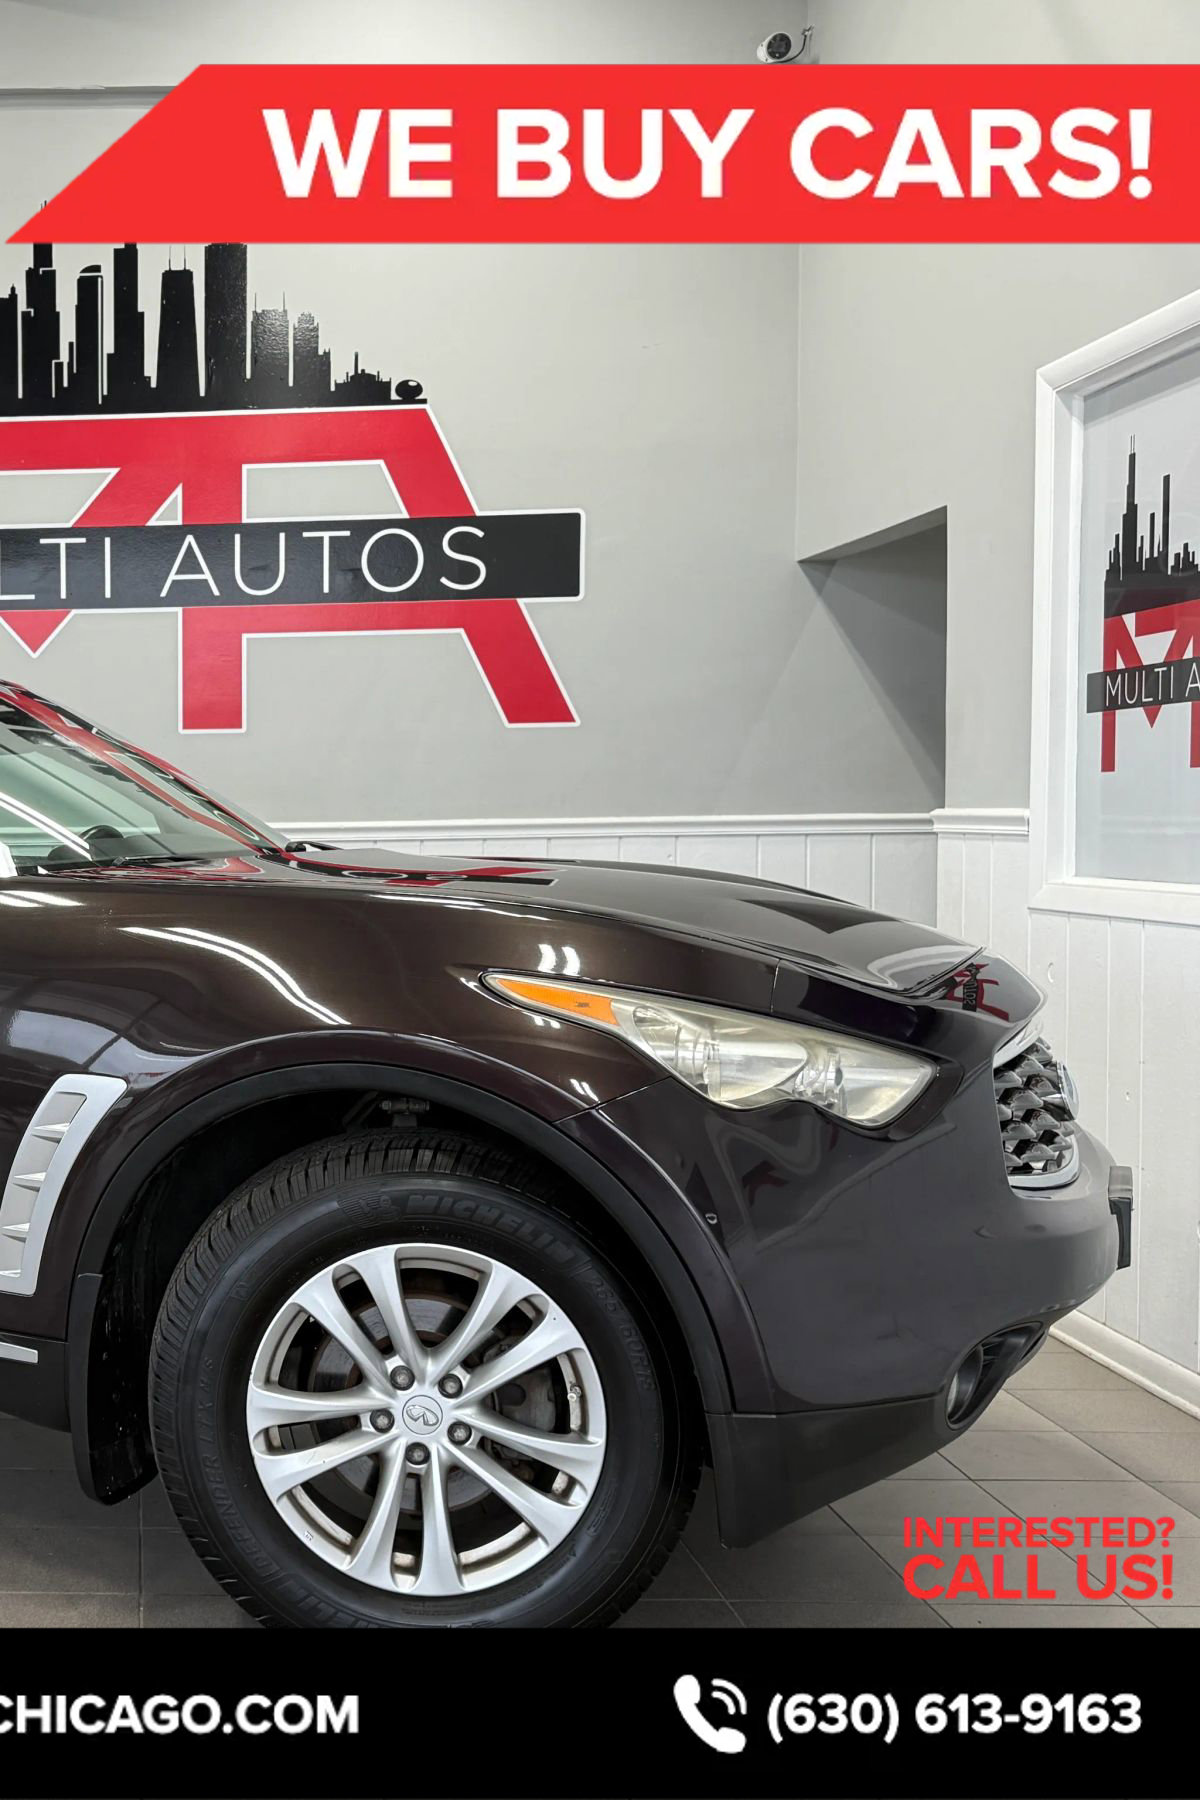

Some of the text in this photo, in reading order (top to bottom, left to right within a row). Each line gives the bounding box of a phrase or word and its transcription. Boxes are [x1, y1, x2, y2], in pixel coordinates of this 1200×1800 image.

[161, 526, 488, 600] AUTOS
[1105, 665, 1175, 708] MULTI
[404, 1193, 580, 1264] MICHELIN
